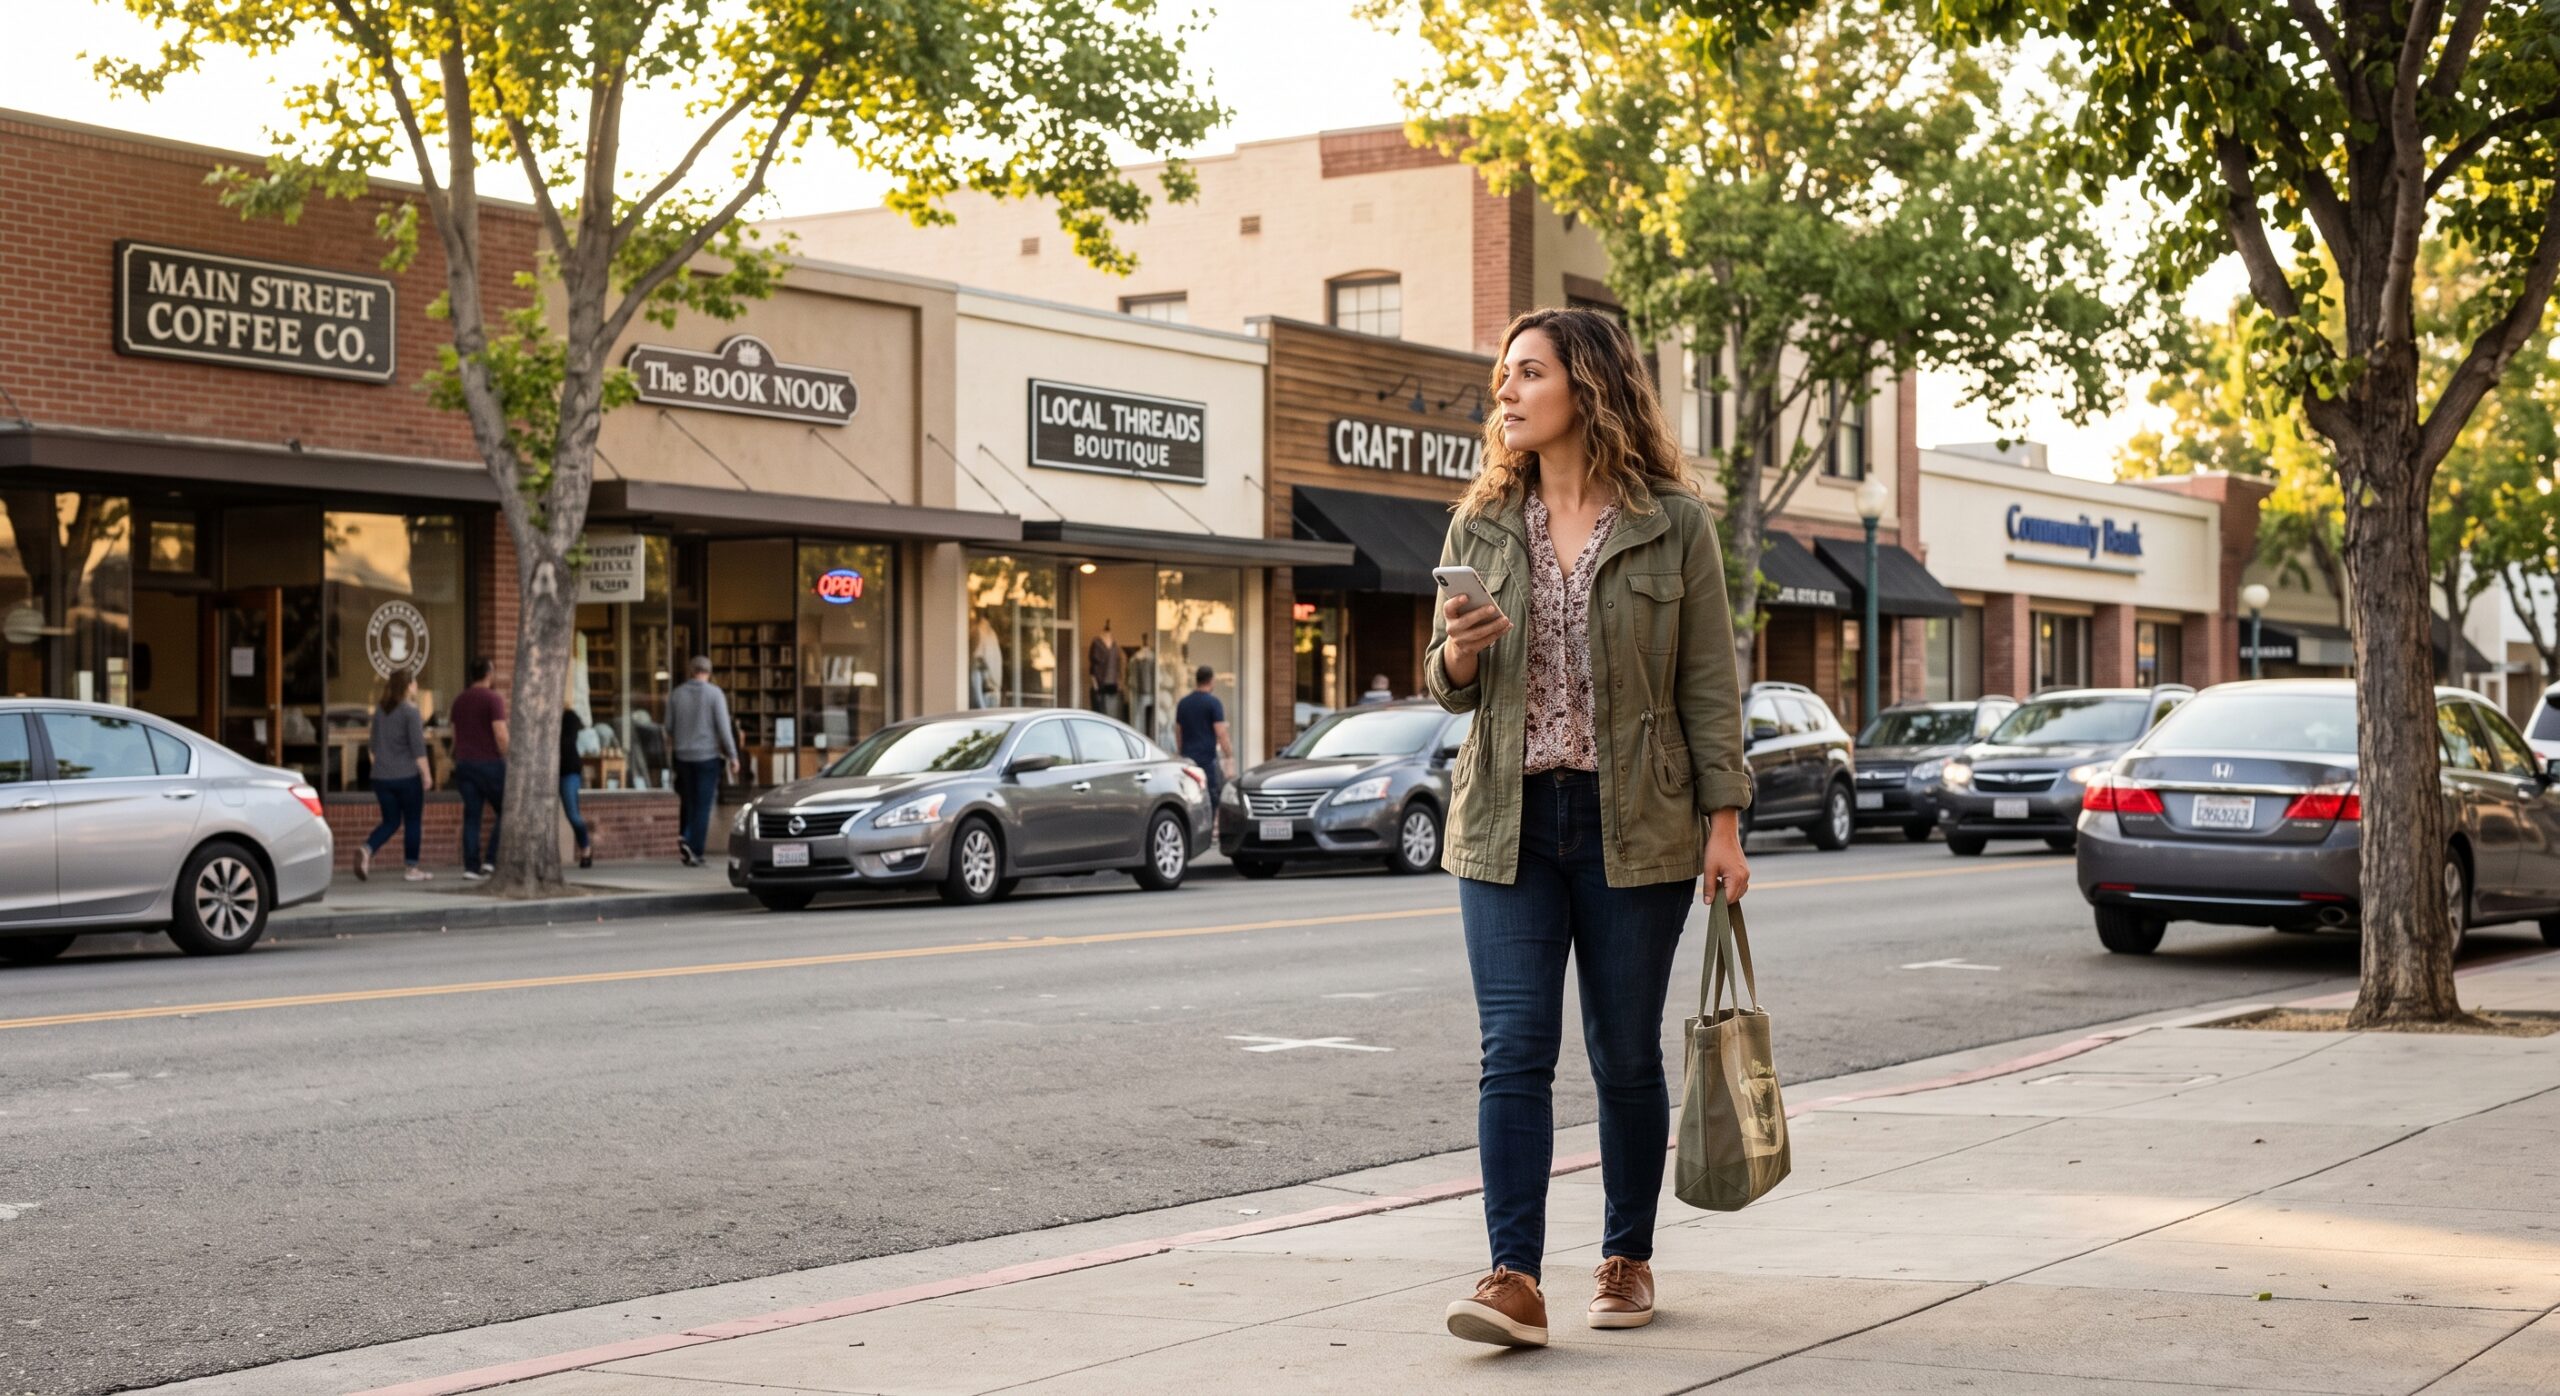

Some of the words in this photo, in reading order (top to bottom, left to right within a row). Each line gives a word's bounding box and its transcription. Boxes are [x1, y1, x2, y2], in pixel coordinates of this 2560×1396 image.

[148, 261, 240, 303] MAIN
[250, 276, 375, 321] STREET
[147, 302, 302, 356] COFFEE
[314, 323, 375, 364] CO.
[644, 360, 687, 393] The
[693, 365, 768, 404] BOOK
[773, 375, 847, 413] NOOK
[1040, 394, 1108, 431] LOCAL
[1110, 404, 1201, 443] THREADS
[1074, 433, 1170, 468] BOUTIQUE
[1336, 419, 1414, 472] CRAFT
[2006, 504, 2100, 559] Community
[2103, 518, 2143, 556] Bank
[818, 574, 863, 598] OPEN
